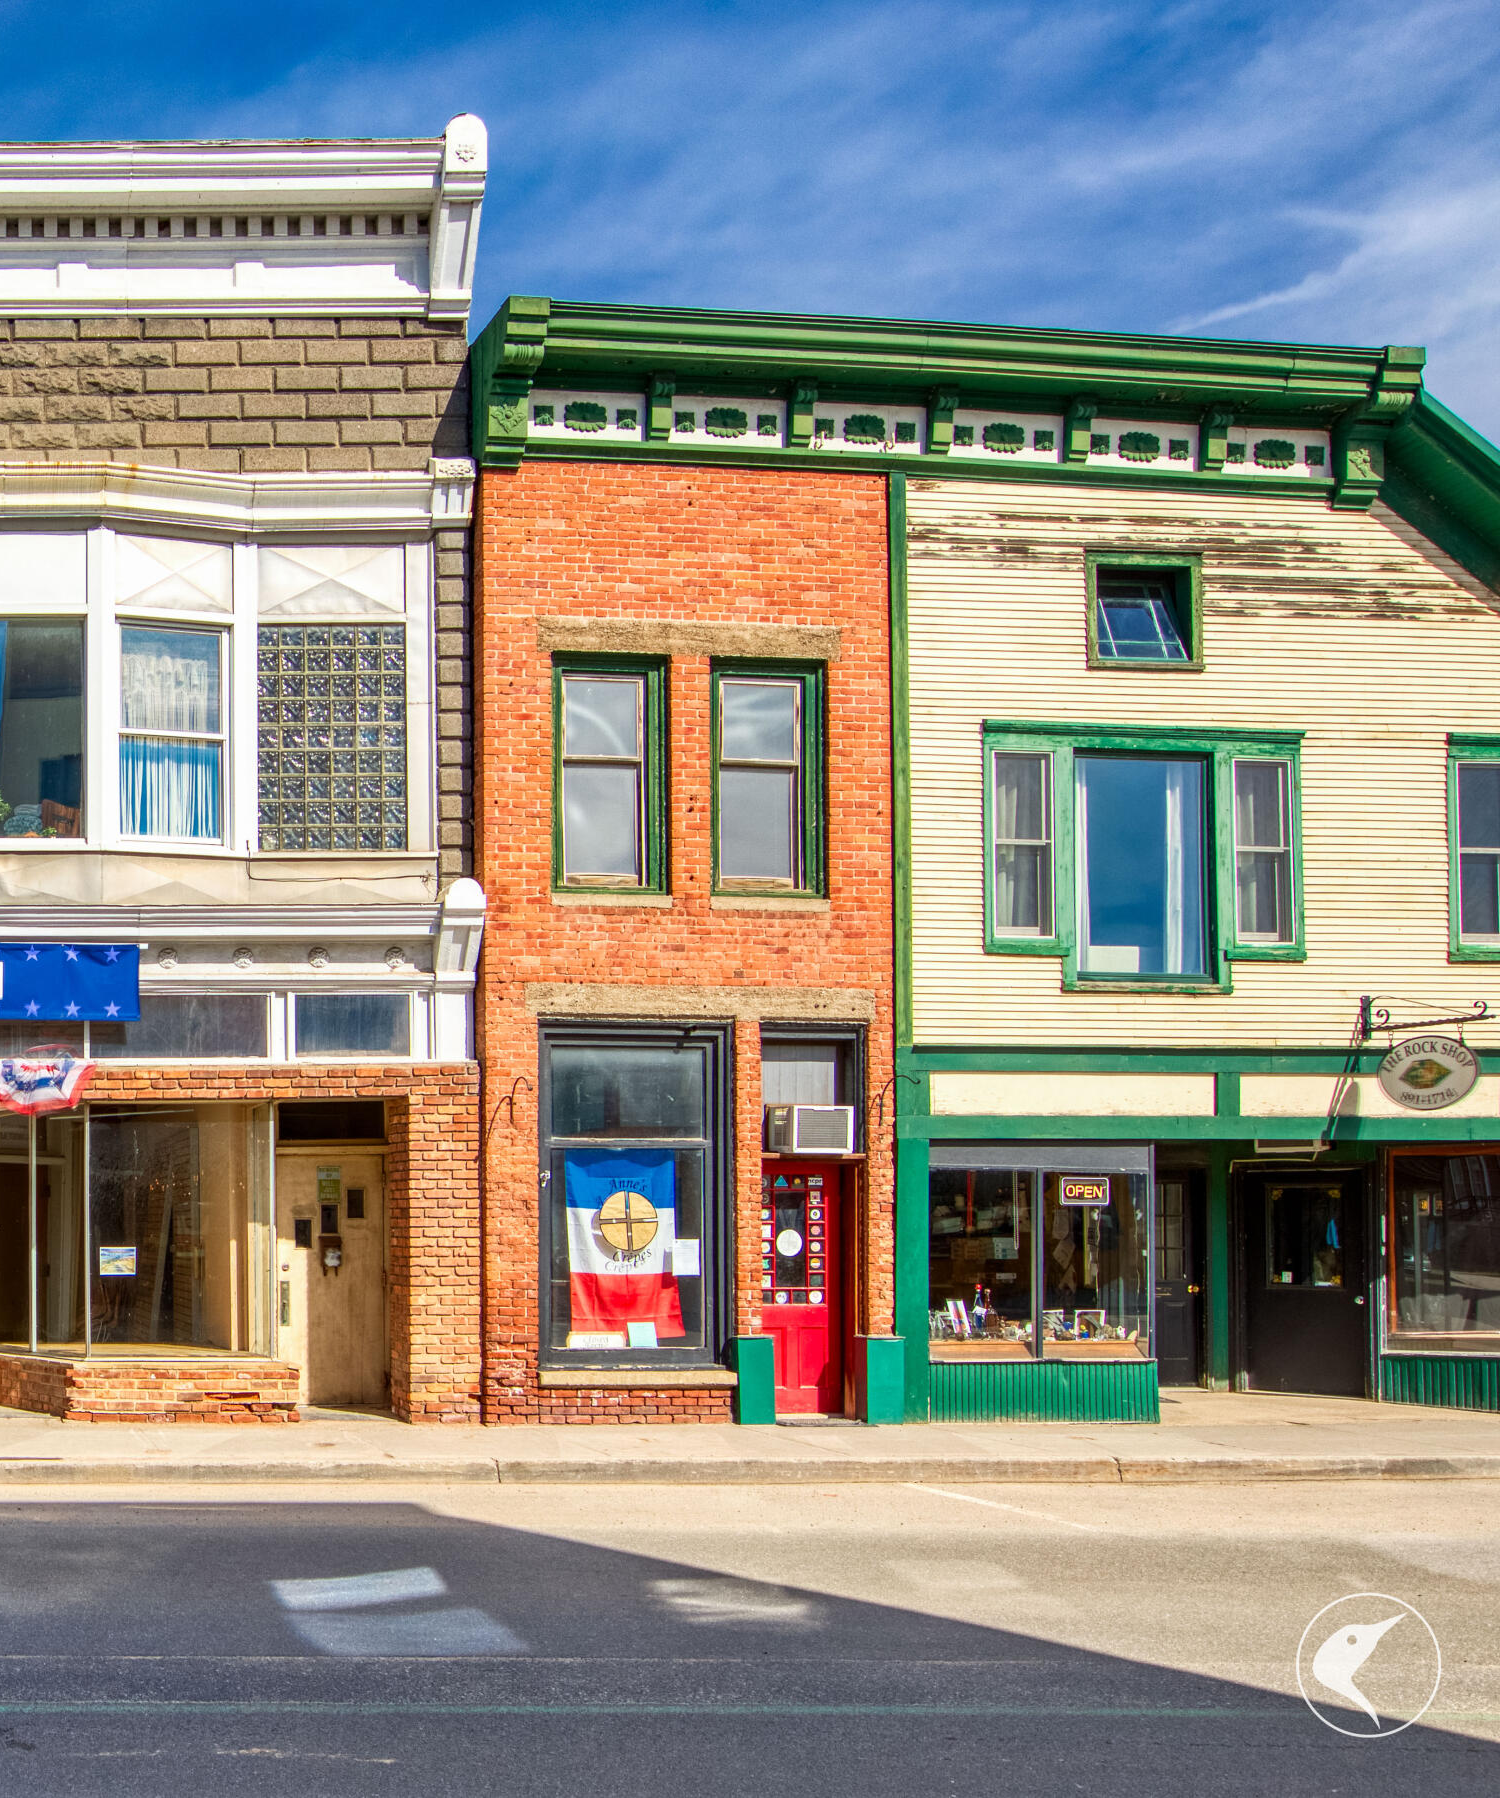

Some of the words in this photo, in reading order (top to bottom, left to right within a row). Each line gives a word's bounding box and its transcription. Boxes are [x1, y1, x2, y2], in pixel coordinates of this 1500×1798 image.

[1380, 1050, 1402, 1072] THE
[1403, 1041, 1439, 1058] ROCK
[1440, 1042, 1476, 1068] SHOP
[610, 1178, 648, 1193] Anne's
[1065, 1184, 1104, 1199] OPEN
